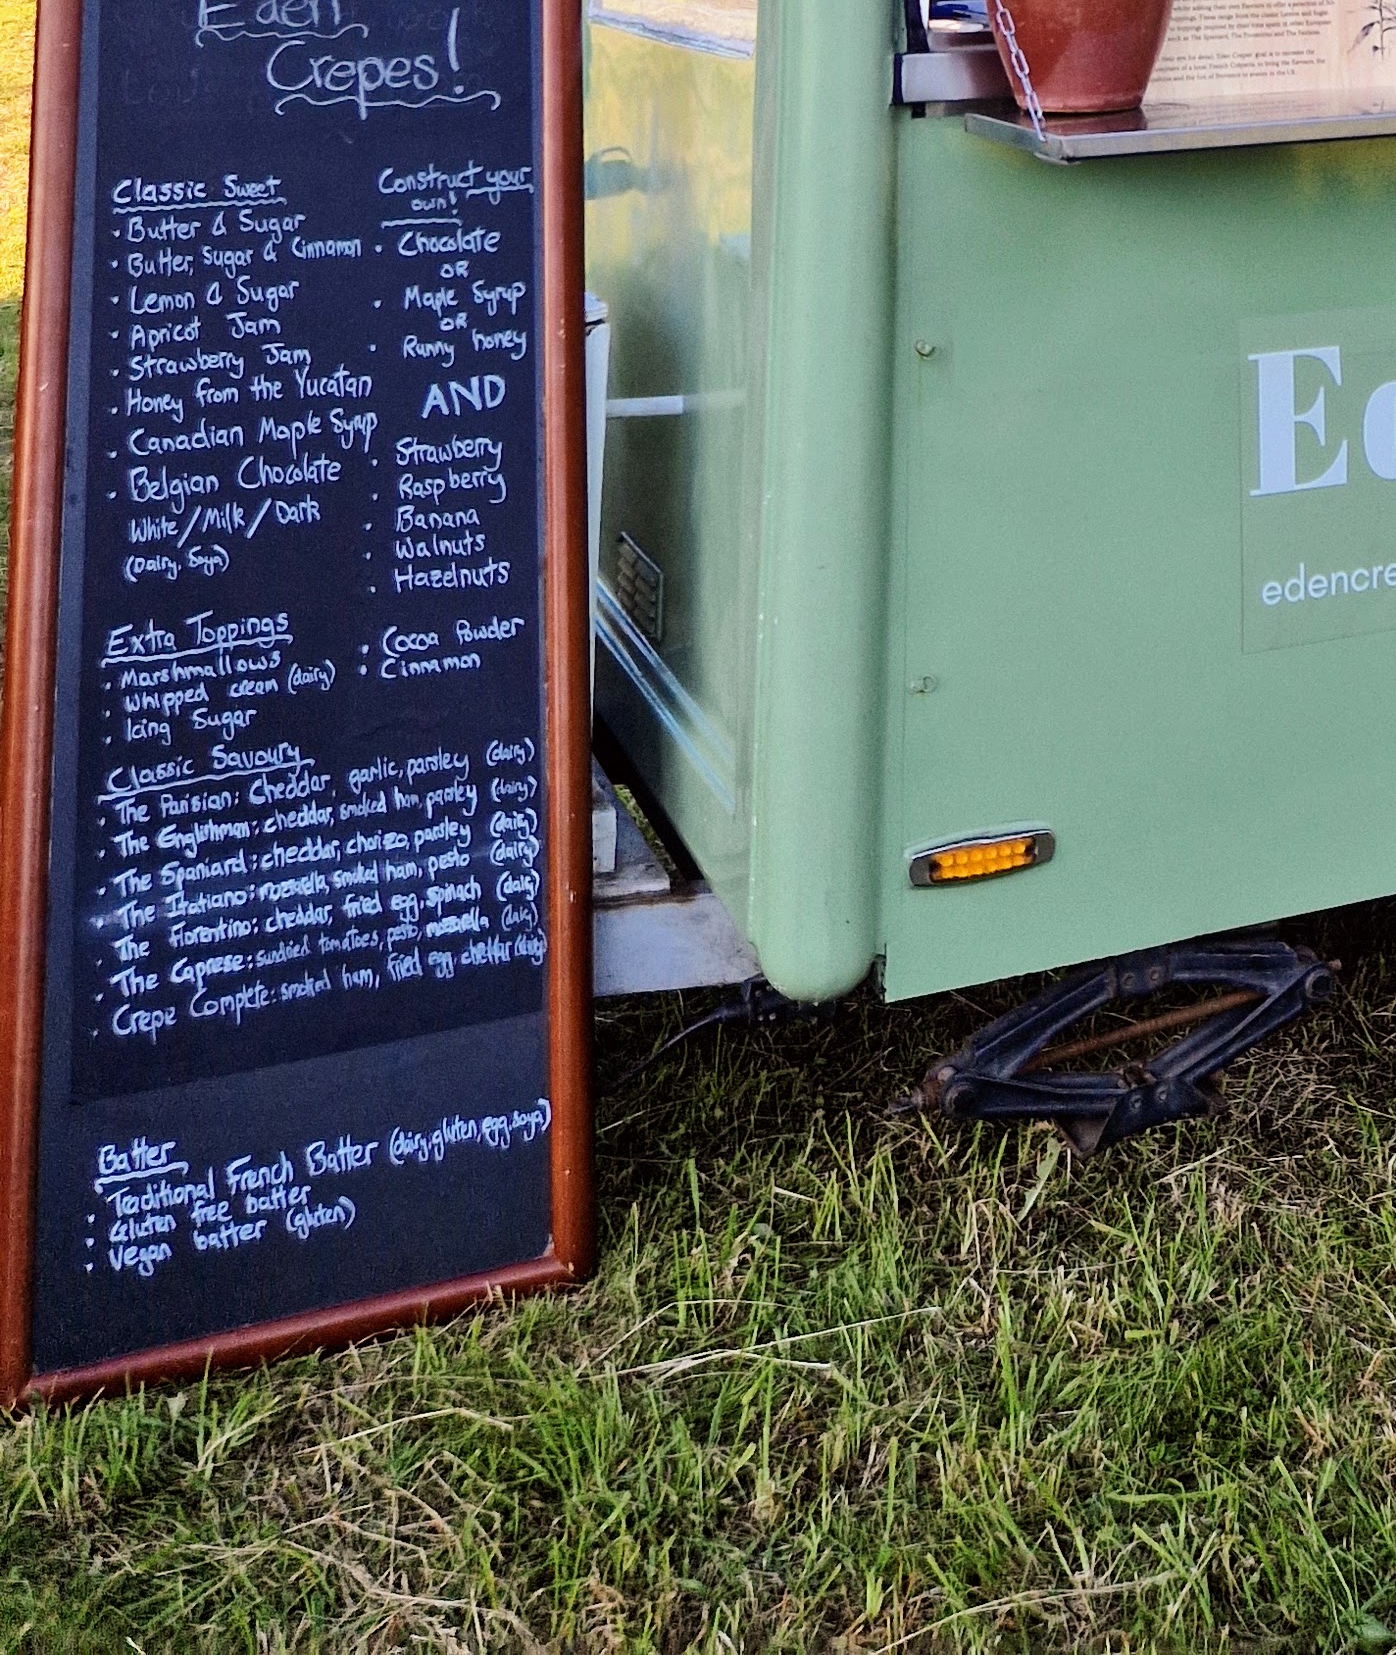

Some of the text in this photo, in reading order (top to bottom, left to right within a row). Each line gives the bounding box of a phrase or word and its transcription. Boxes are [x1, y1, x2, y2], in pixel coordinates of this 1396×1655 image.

[112, 174, 282, 204] Classic Sweet
[379, 160, 531, 205] Construct your
[127, 215, 201, 243] Butter
[239, 209, 306, 244] Sugar
[398, 227, 501, 257] Chocolate
[291, 236, 362, 260] Cinnamon
[440, 260, 470, 278] OR
[130, 285, 196, 315] Lemon
[236, 275, 300, 312] Sugar
[404, 279, 526, 317] Maple Syrup
[130, 312, 281, 353] Apricot Jam
[439, 312, 468, 332] OR
[129, 343, 311, 381] Strawberry Jam
[403, 328, 527, 368] Runny honey
[127, 363, 372, 423] Honey from the Yucatan
[421, 374, 506, 419] AND
[128, 408, 378, 459] Canadian Maple Syrup
[395, 434, 502, 472] Strawberry
[130, 452, 342, 514] Belgian Chocolate
[398, 468, 507, 504] Raspberry
[395, 505, 480, 532] Banana
[395, 529, 486, 560] Walnuts
[394, 556, 510, 593] Hazelnuts
[106, 609, 289, 656] Extra Toppings
[382, 615, 525, 658] Cocoa Powder
[120, 650, 281, 690] Marshmallows
[229, 677, 279, 698] cream
[287, 658, 336, 694] (dairy)
[380, 652, 481, 679] Cinnamon
[126, 707, 257, 745] Icing Sugar
[106, 741, 301, 793] Classic Savoury
[115, 796, 151, 825] The
[406, 746, 469, 786] parsley
[486, 736, 535, 767] (dairy)
[113, 829, 151, 859] The
[425, 778, 478, 819] parsley
[490, 774, 538, 803] (dairy)
[112, 866, 153, 897] The
[413, 814, 471, 853] parsley
[489, 806, 538, 840] (dairy)
[116, 898, 157, 932] The
[426, 845, 471, 881] pesto
[489, 836, 541, 868] (dairy)
[113, 933, 151, 963] The
[341, 889, 384, 919] fried
[425, 874, 483, 918] spinach
[110, 964, 161, 999] The
[111, 1002, 178, 1046] Crepe
[98, 1135, 177, 1175] Batter
[106, 1165, 216, 1218] Traditional
[226, 1150, 295, 1196] French
[306, 1133, 380, 1178] Batter
[109, 1185, 312, 1244] Gluten free batter
[108, 1195, 356, 1276] Vegan batter (gluten)
